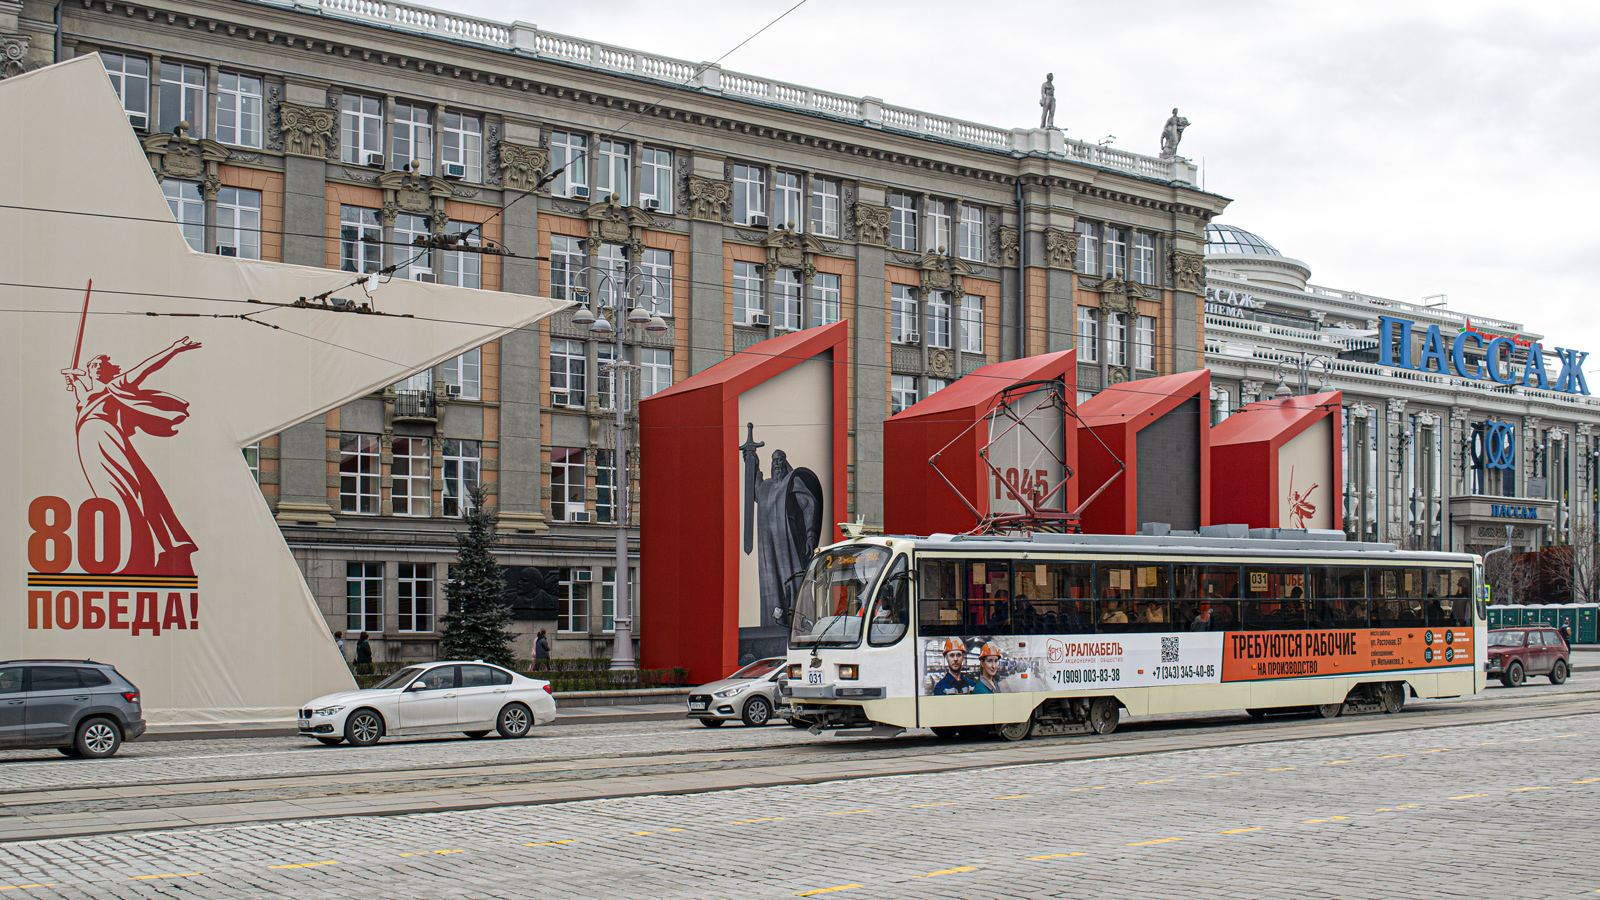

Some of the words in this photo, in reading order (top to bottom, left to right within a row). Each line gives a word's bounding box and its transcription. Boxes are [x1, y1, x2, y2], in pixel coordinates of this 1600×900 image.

[1377, 315, 1592, 395] ПАССАЖ
[991, 467, 1049, 503] 1945
[1491, 504, 1538, 519] ПАССАЖ
[28, 495, 121, 574] 80
[826, 555, 832, 568] 2
[1251, 574, 1266, 584] 031
[28, 590, 199, 636] ПОБЕДА!
[1065, 642, 1123, 657] УРАЛКАБЕЛЬ
[1231, 633, 1302, 659] ТРЕБУЮТСЯ
[1306, 632, 1357, 656] РАБОЧИЕ
[1052, 670, 1061, 683] +7
[1063, 669, 1082, 684] (909)
[1083, 668, 1120, 683] 003-83-38
[1152, 666, 1160, 679] +7
[1162, 665, 1179, 679] (343)
[1180, 664, 1215, 678] 345-40-85
[1257, 662, 1266, 676] НА
[1268, 660, 1318, 676] ПРОИЗВОДСТВО
[808, 673, 822, 684] 031
